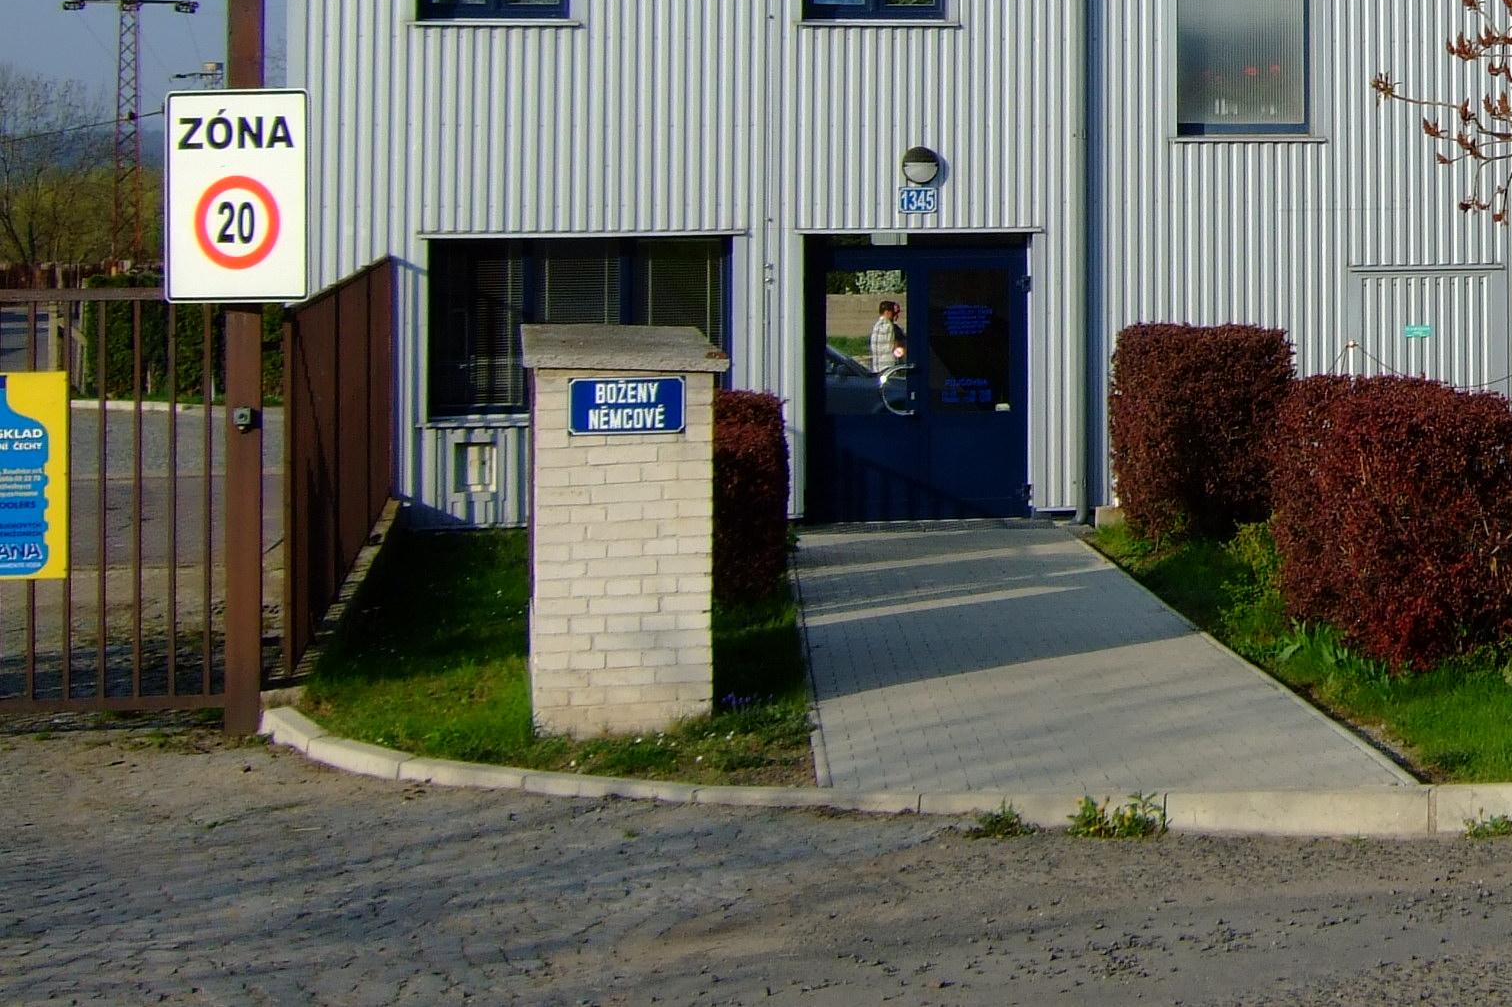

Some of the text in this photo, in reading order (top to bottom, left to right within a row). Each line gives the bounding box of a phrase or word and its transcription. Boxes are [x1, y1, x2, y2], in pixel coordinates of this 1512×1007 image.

[177, 108, 295, 150] ZÓNA
[901, 190, 934, 210] 1345
[216, 201, 255, 244] 20
[595, 380, 660, 404] BOŽENY
[588, 404, 666, 430] NĚMCOVÉ
